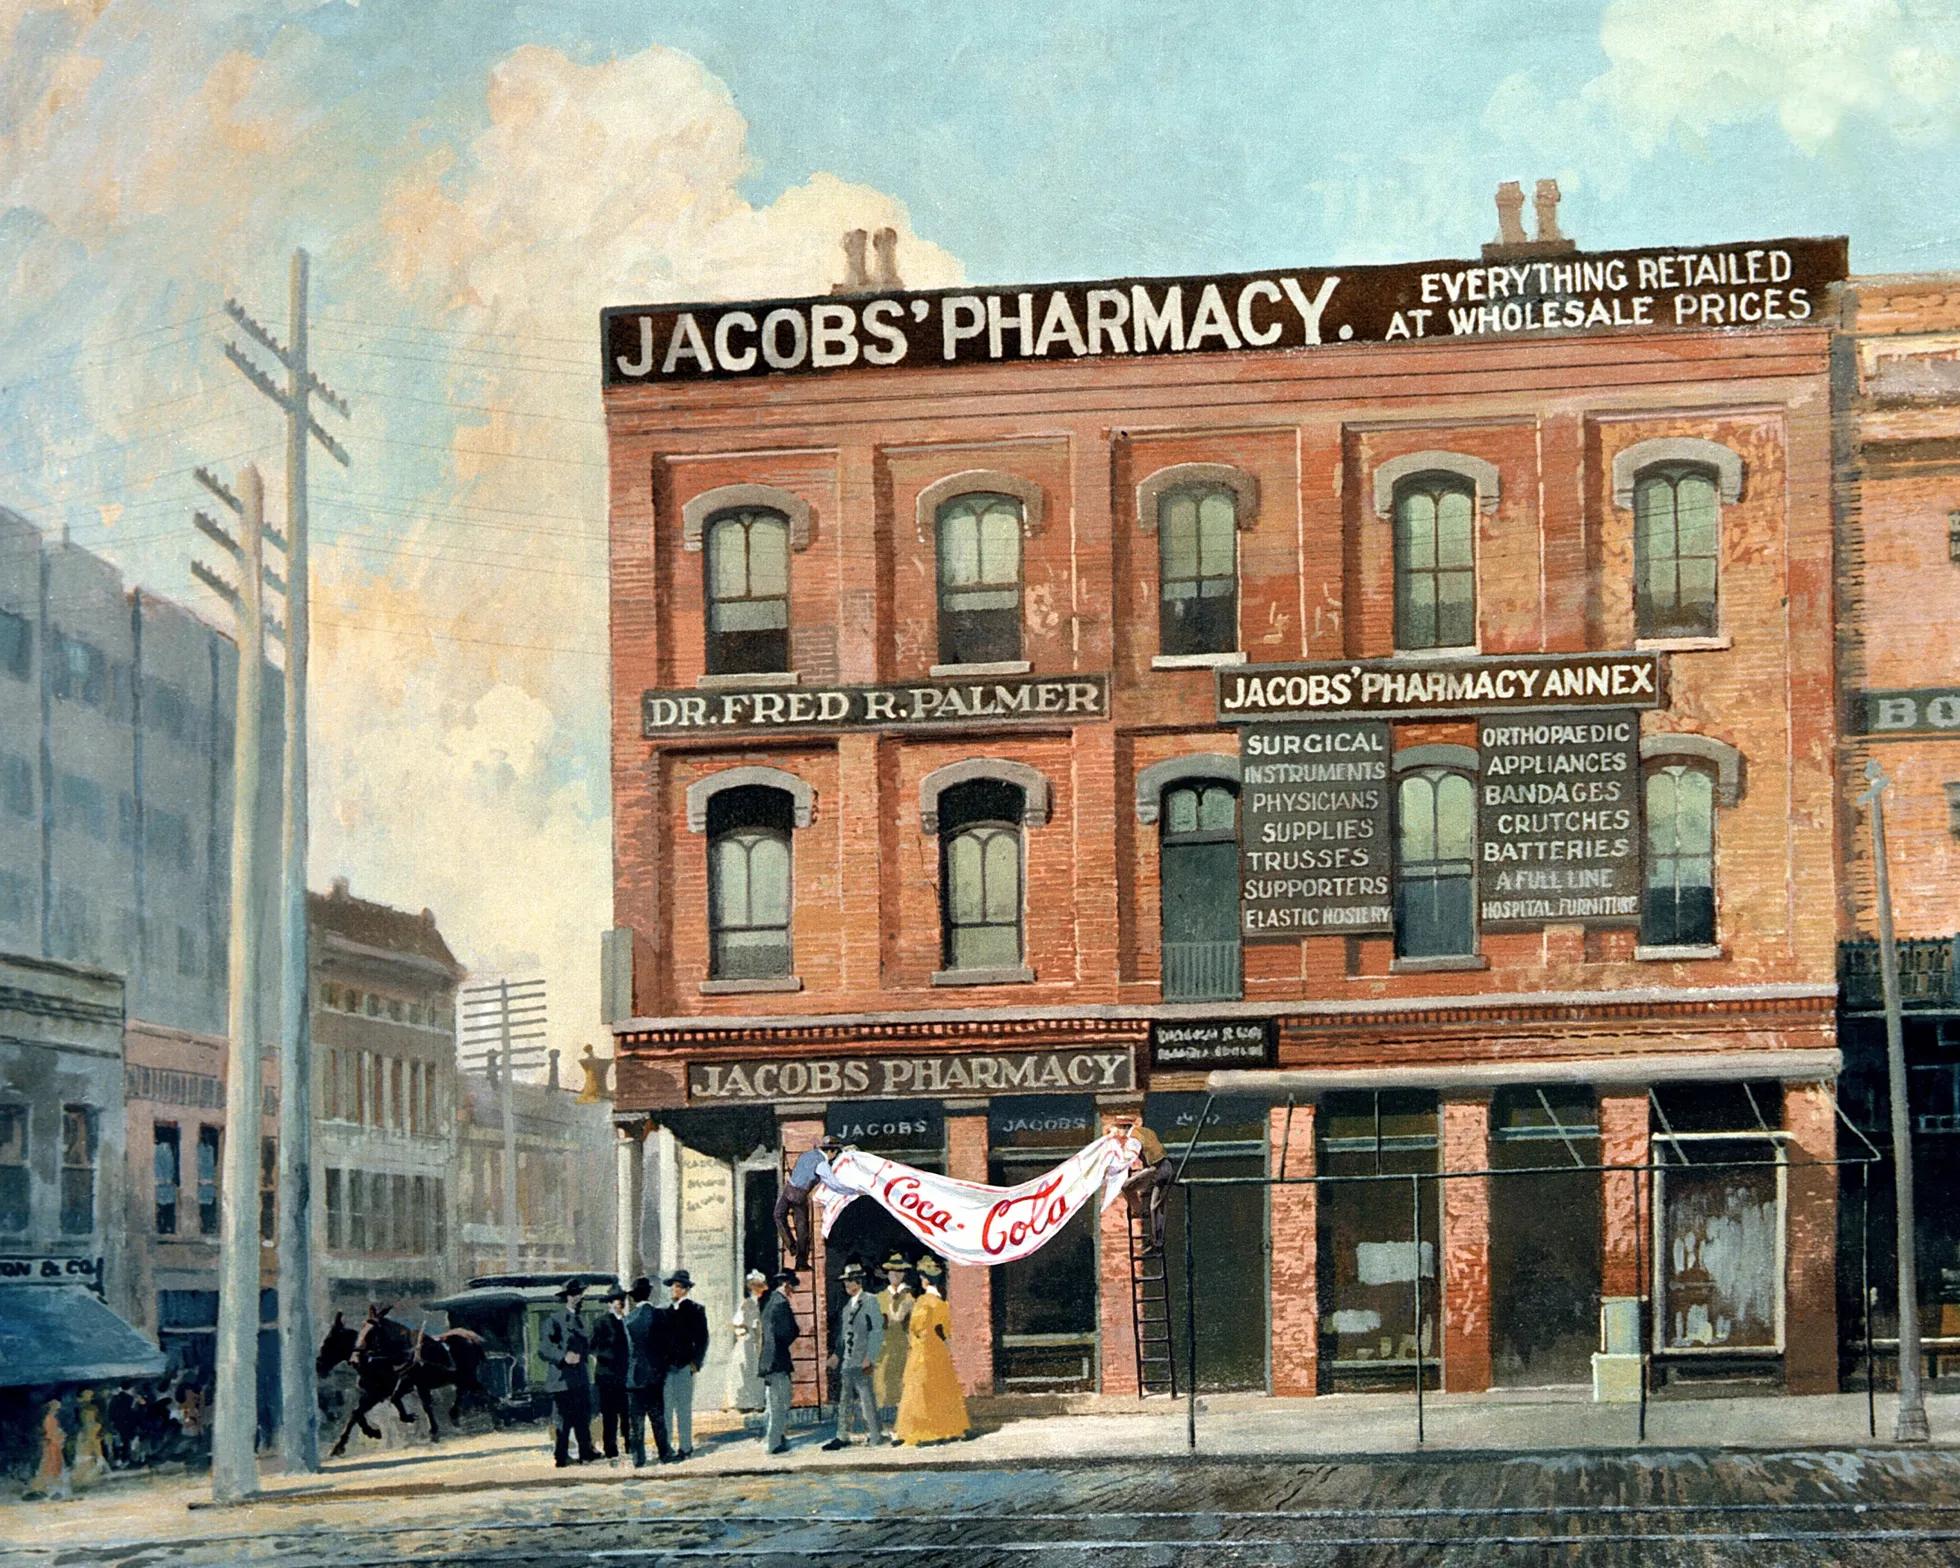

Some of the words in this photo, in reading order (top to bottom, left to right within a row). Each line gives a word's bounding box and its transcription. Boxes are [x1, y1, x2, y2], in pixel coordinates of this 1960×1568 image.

[1420, 259, 1629, 304] EVERYTHING
[1637, 250, 1792, 290] RETAILED
[616, 299, 928, 376] JACOBS'
[942, 275, 1354, 360] PHARMACY.
[1385, 308, 1433, 342] AT
[1447, 296, 1654, 336] WHOLESALE
[1674, 288, 1812, 325] PRICES
[1224, 666, 1361, 709] JACOBS'
[1360, 669, 1540, 703] PHARMACY
[1542, 663, 1654, 697] ANNEX
[1247, 731, 1385, 756] SURGICAL
[1482, 722, 1631, 748] ORTHOPAEDIC
[1244, 761, 1386, 784] INSTRUMENTS
[1486, 752, 1628, 776] APPLIANCES
[1252, 789, 1379, 813] PHYSICIANS
[1483, 781, 1622, 806] BANDAGES
[1262, 818, 1374, 843] SUPPLIES
[1497, 809, 1631, 835] CRUTCHES
[1246, 847, 1369, 872] TRUSSES
[1483, 838, 1630, 863] BATTERIES
[1243, 875, 1389, 900] SUPPORTERS
[1494, 870, 1512, 891] A
[1515, 869, 1563, 891] FULL
[1566, 868, 1614, 889] LINE
[1245, 907, 1319, 929] ELASTIC
[1322, 905, 1392, 926] HOSIERY
[1481, 899, 1555, 920] HOSPITAL
[691, 1061, 870, 1097] JACOBS
[879, 1054, 1128, 1093] PHARMACY
[836, 1120, 928, 1140] JACOBS
[981, 1173, 1070, 1256] Cola
[40, 1260, 62, 1278] &
